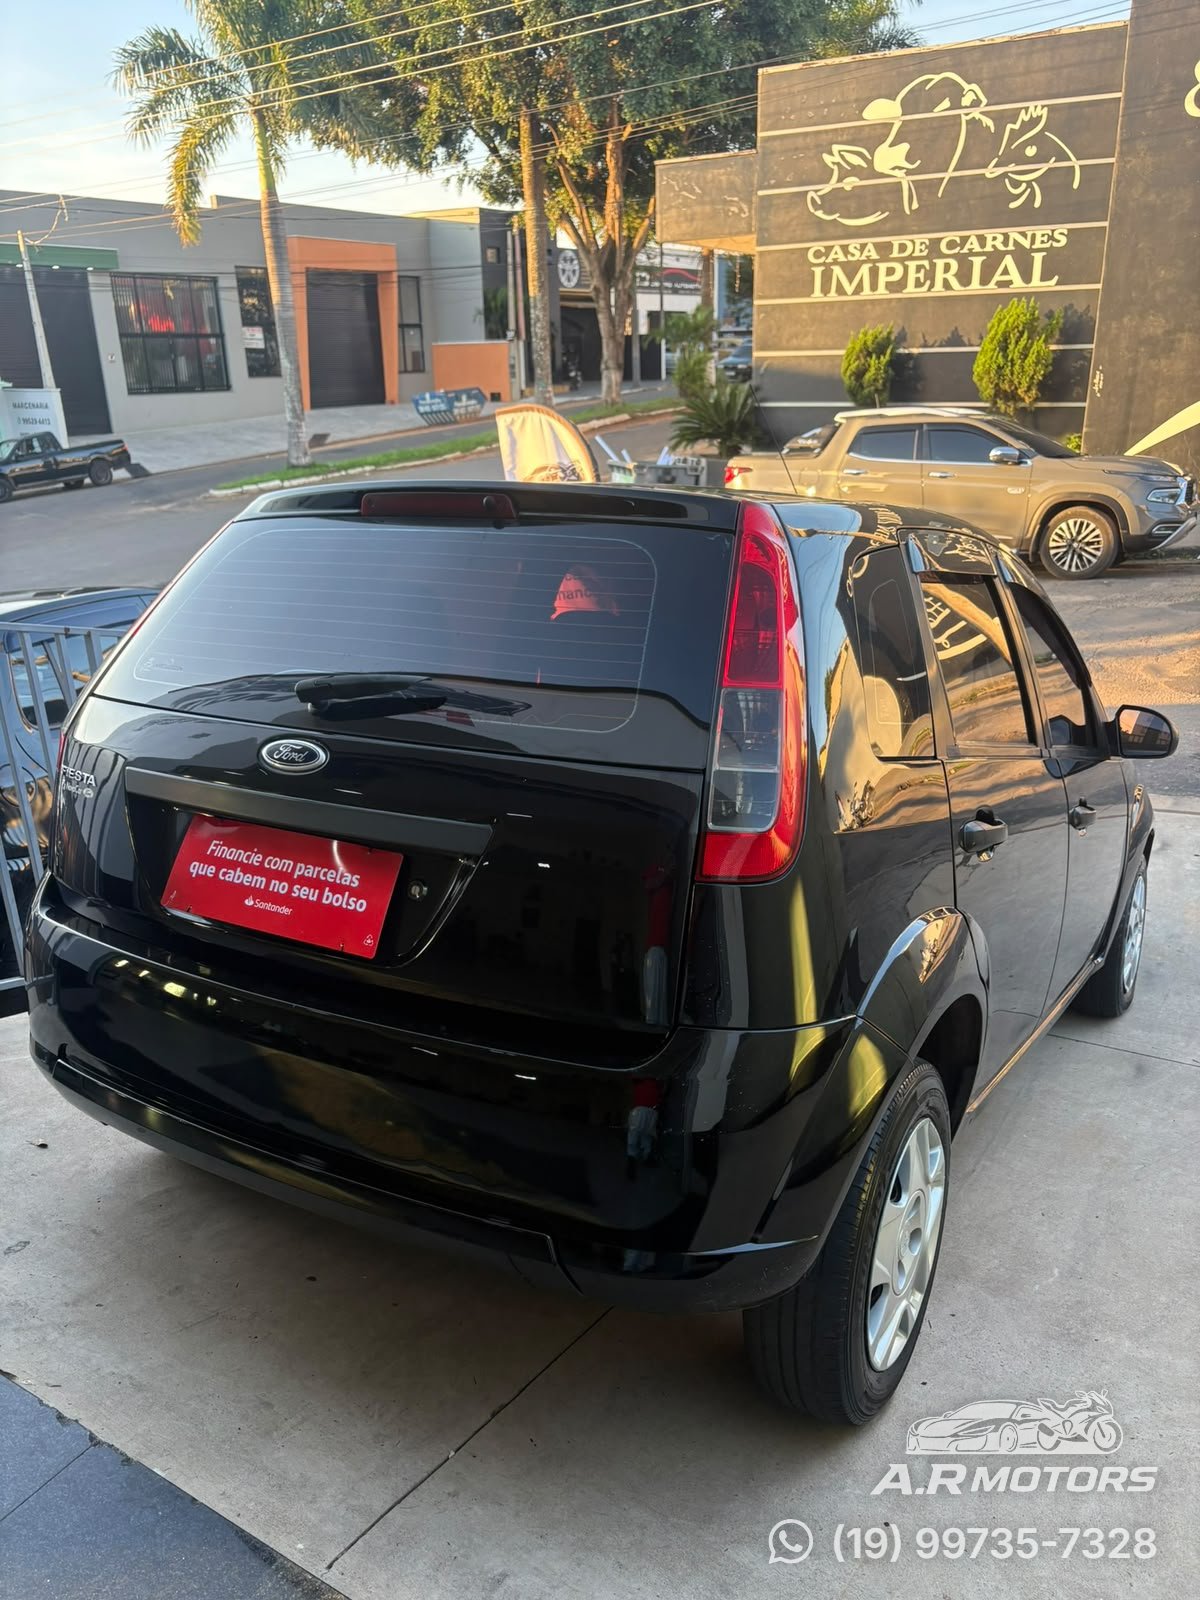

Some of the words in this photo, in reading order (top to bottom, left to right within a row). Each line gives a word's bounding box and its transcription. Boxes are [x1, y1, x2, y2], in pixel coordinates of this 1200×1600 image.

[807, 242, 880, 264] CASA
[889, 239, 930, 258] DE
[939, 228, 1069, 255] CARNES
[809, 251, 1060, 298] IMPERIAL
[273, 743, 309, 762] Ford
[207, 840, 262, 866] Financie
[264, 855, 294, 873] com
[294, 862, 361, 888] parcelas
[189, 860, 216, 878] que
[218, 865, 266, 890] cabem
[269, 878, 289, 895] no
[291, 884, 318, 902] seu
[322, 887, 367, 913] bolso
[254, 899, 293, 916] Santander
